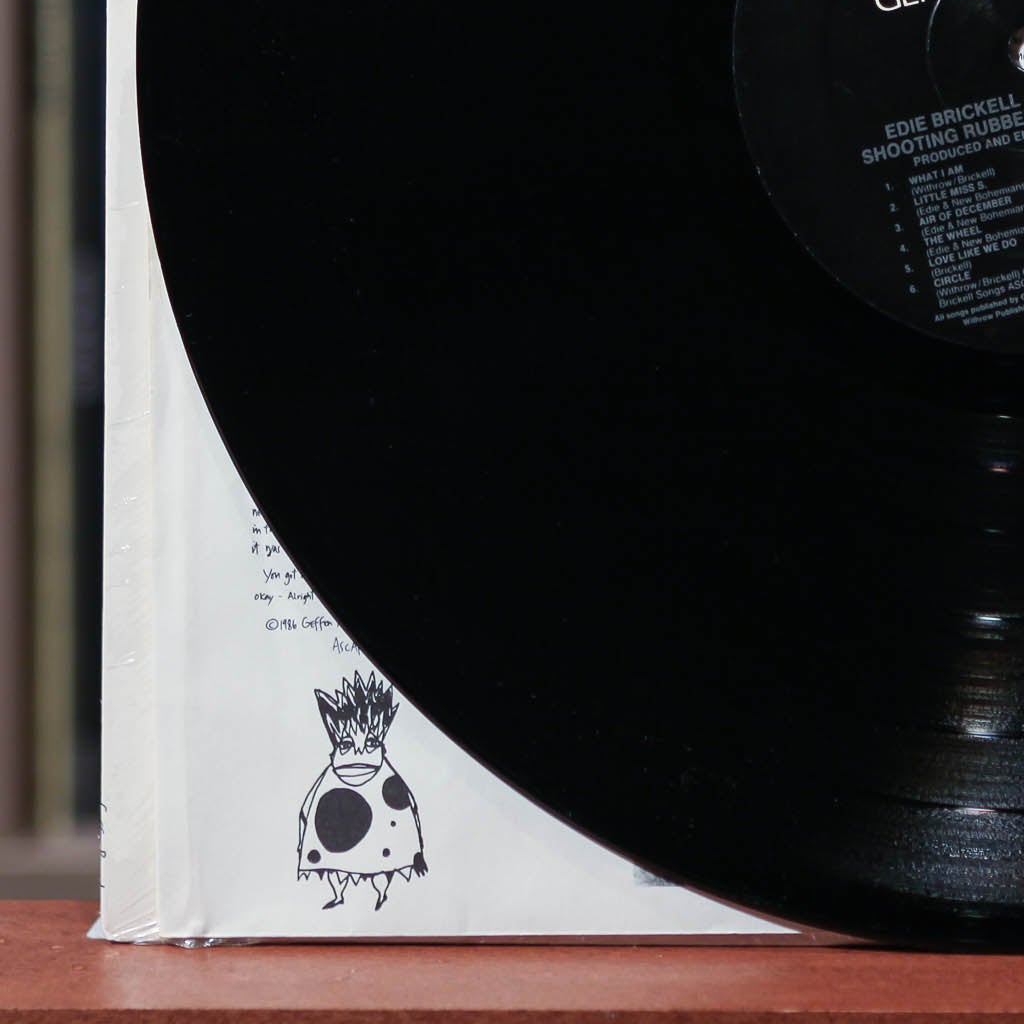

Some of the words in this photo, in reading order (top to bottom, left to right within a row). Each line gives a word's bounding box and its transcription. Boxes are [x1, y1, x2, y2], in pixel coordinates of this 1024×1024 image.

[884, 115, 929, 140] EDIE
[930, 93, 1022, 128] BRICKELL
[861, 127, 959, 165] SHOOTING
[912, 140, 982, 167] PRODUCED
[985, 134, 1011, 149] AND
[908, 170, 938, 185] WHAT
[940, 168, 945, 178] I
[947, 164, 964, 176] AM
[913, 189, 948, 206] LITTLE
[949, 183, 975, 197] MISS
[916, 204, 940, 218] (Edie
[951, 196, 973, 207] New
[919, 214, 937, 227] AIR
[938, 210, 953, 222] OF
[954, 195, 1012, 218] DECEMBER
[921, 224, 945, 239] (Edie
[955, 217, 978, 228] New
[923, 233, 945, 247] THE
[945, 225, 983, 241] WHEEL
[926, 245, 950, 259] (Edie
[961, 237, 983, 248] New
[928, 252, 956, 268] LOVE
[957, 246, 981, 260] LIKE
[982, 241, 1000, 254] WE
[1001, 237, 1018, 249] DO
[930, 260, 973, 279] (Brickell)
[933, 270, 971, 288] CIRCLE
[938, 292, 974, 309] Brickell
[975, 285, 1006, 300] Songs
